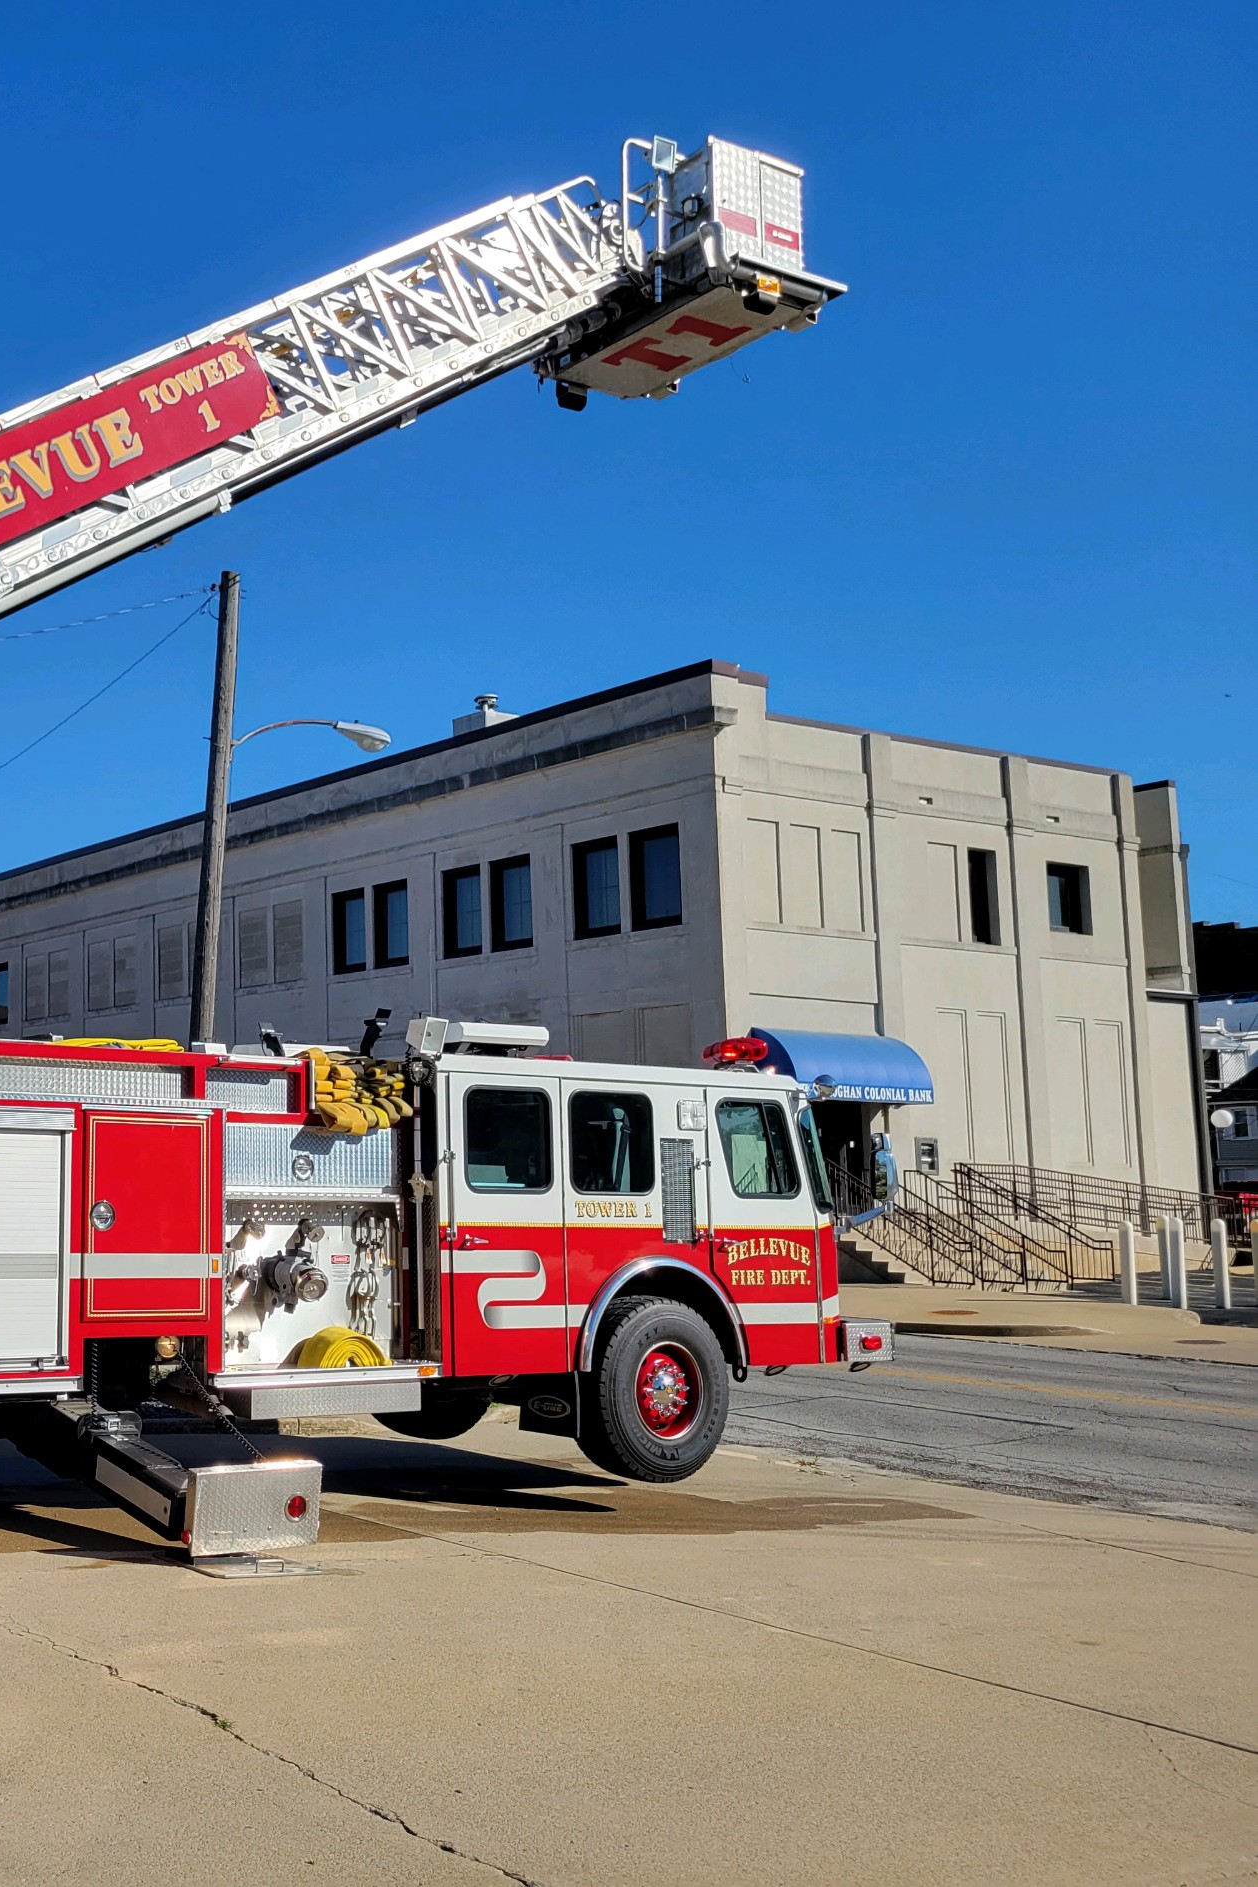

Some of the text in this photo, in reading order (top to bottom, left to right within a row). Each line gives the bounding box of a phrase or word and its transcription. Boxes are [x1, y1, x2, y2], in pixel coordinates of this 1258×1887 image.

[174, 339, 187, 351] 85
[601, 315, 752, 373] T1
[139, 350, 246, 414] TOWER
[198, 399, 221, 433] 1
[864, 1086, 907, 1101] COLONIAL
[908, 1088, 933, 1102] BANK
[574, 1200, 653, 1218] TOWER 1
[727, 1237, 811, 1267] BELLEVUE
[730, 1269, 812, 1286] FIRE DEPT.
